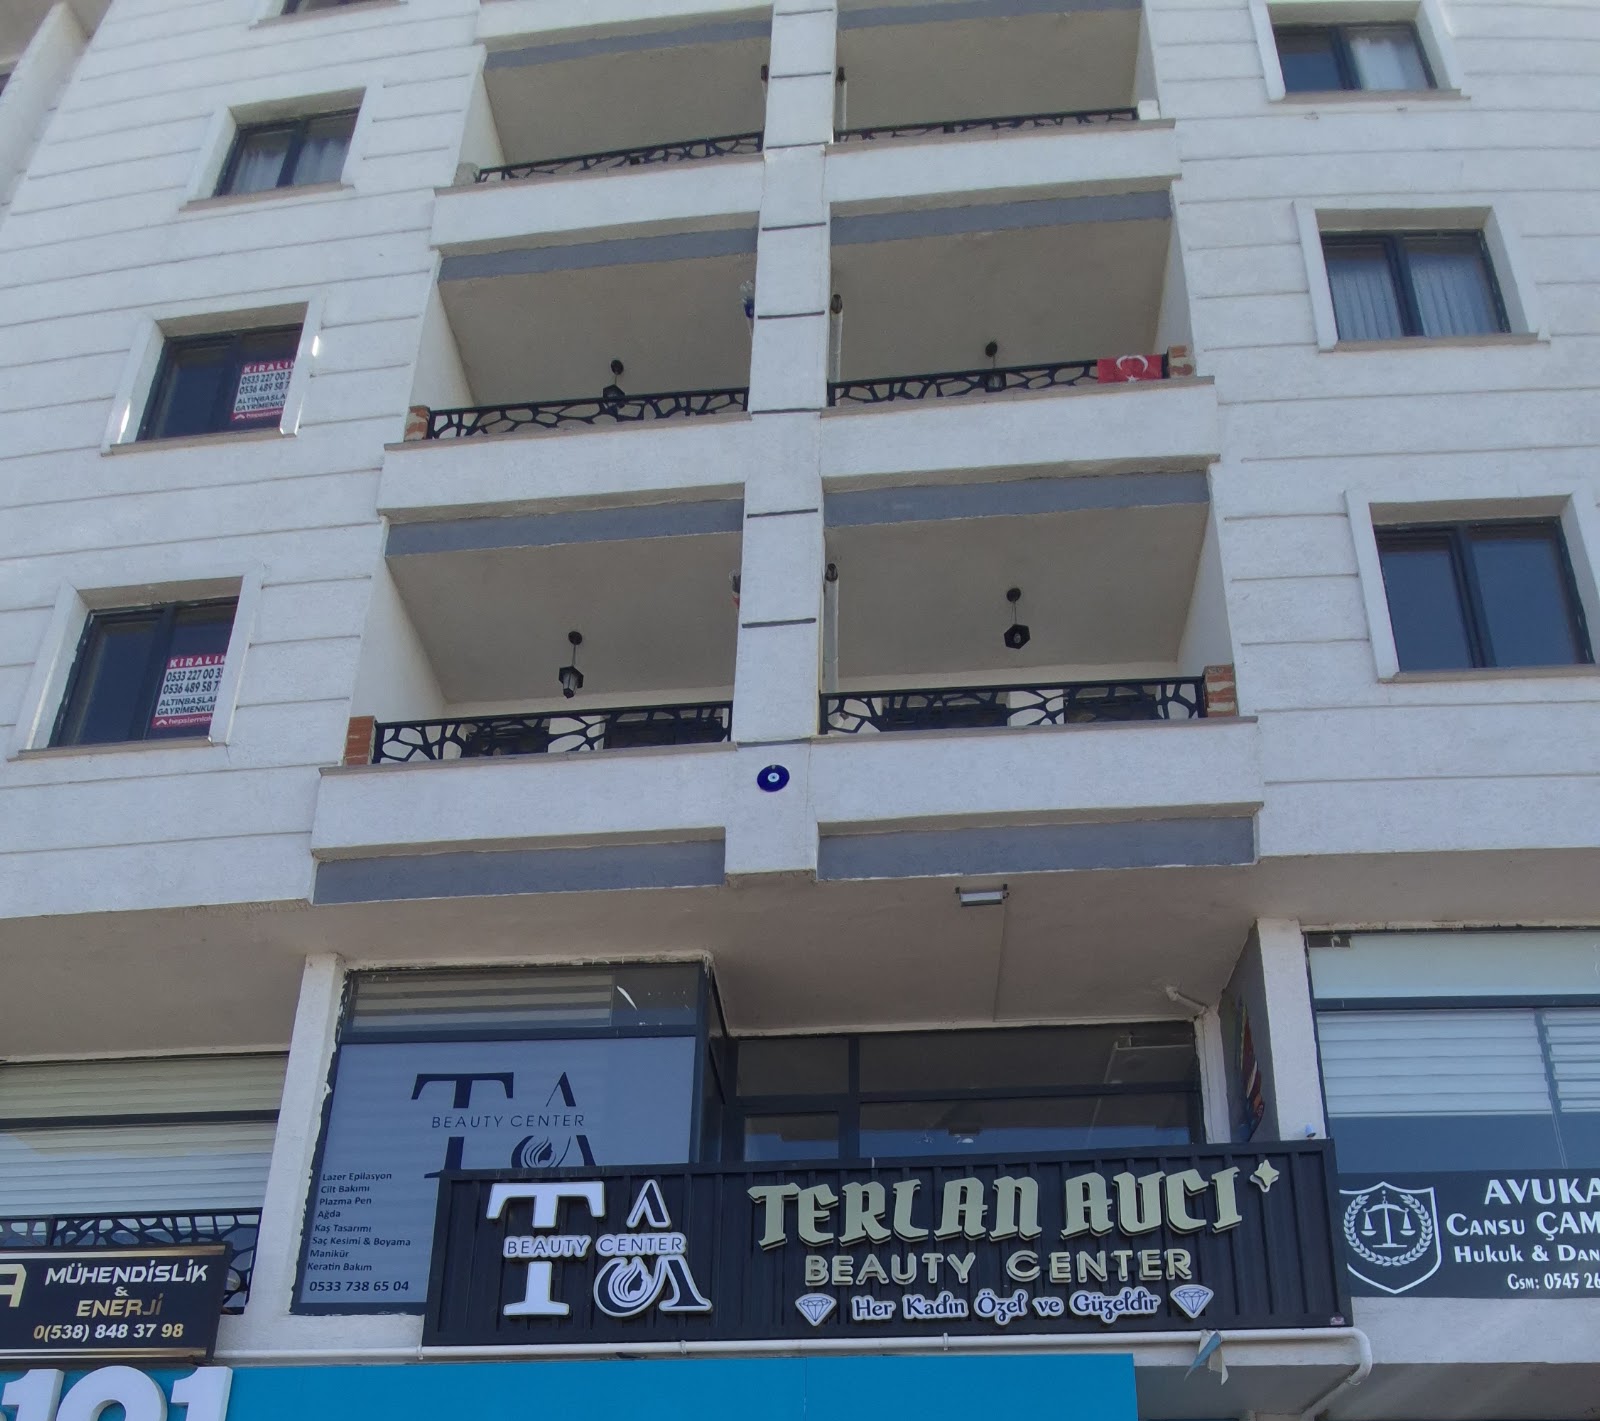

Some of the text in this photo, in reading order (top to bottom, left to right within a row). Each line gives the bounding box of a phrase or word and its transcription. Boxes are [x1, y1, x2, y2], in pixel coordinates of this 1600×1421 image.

[166, 671, 187, 682] 0533
[187, 670, 202, 681] 227
[203, 668, 214, 679] 00
[163, 683, 183, 695] 0536
[185, 682, 200, 693] 489
[202, 681, 211, 692] 58
[431, 1114, 585, 1128] BEAUTY CENTER
[322, 1172, 392, 1182] Lazer Epilasyon
[321, 1185, 370, 1194] Cilt Bakımı
[319, 1197, 372, 1206] Plazma Pen
[317, 1210, 341, 1219] Ağda
[747, 1175, 1043, 1251] TERLAN
[315, 1224, 371, 1233] Kaş Tasarımı
[312, 1237, 411, 1247] Saç Kesimi & Boyama
[504, 1234, 685, 1257] BEAUTY CENTER
[309, 1249, 349, 1258] Manikür
[1531, 1244, 1550, 1262] &
[45, 1258, 209, 1286] MÜHENDİSLİK
[307, 1262, 372, 1271] Keratin Bakım
[804, 1248, 1193, 1286] BEAUTY CENTER
[309, 1280, 409, 1292] 0533 738 65 04
[1544, 1272, 1580, 1290] 0545
[114, 1286, 129, 1297] &
[75, 1293, 164, 1318] ENERJİ
[855, 1288, 1159, 1322] Her Kadın Özel ve Güzeldir
[33, 1323, 184, 1342] 0(538) 848 37 98
